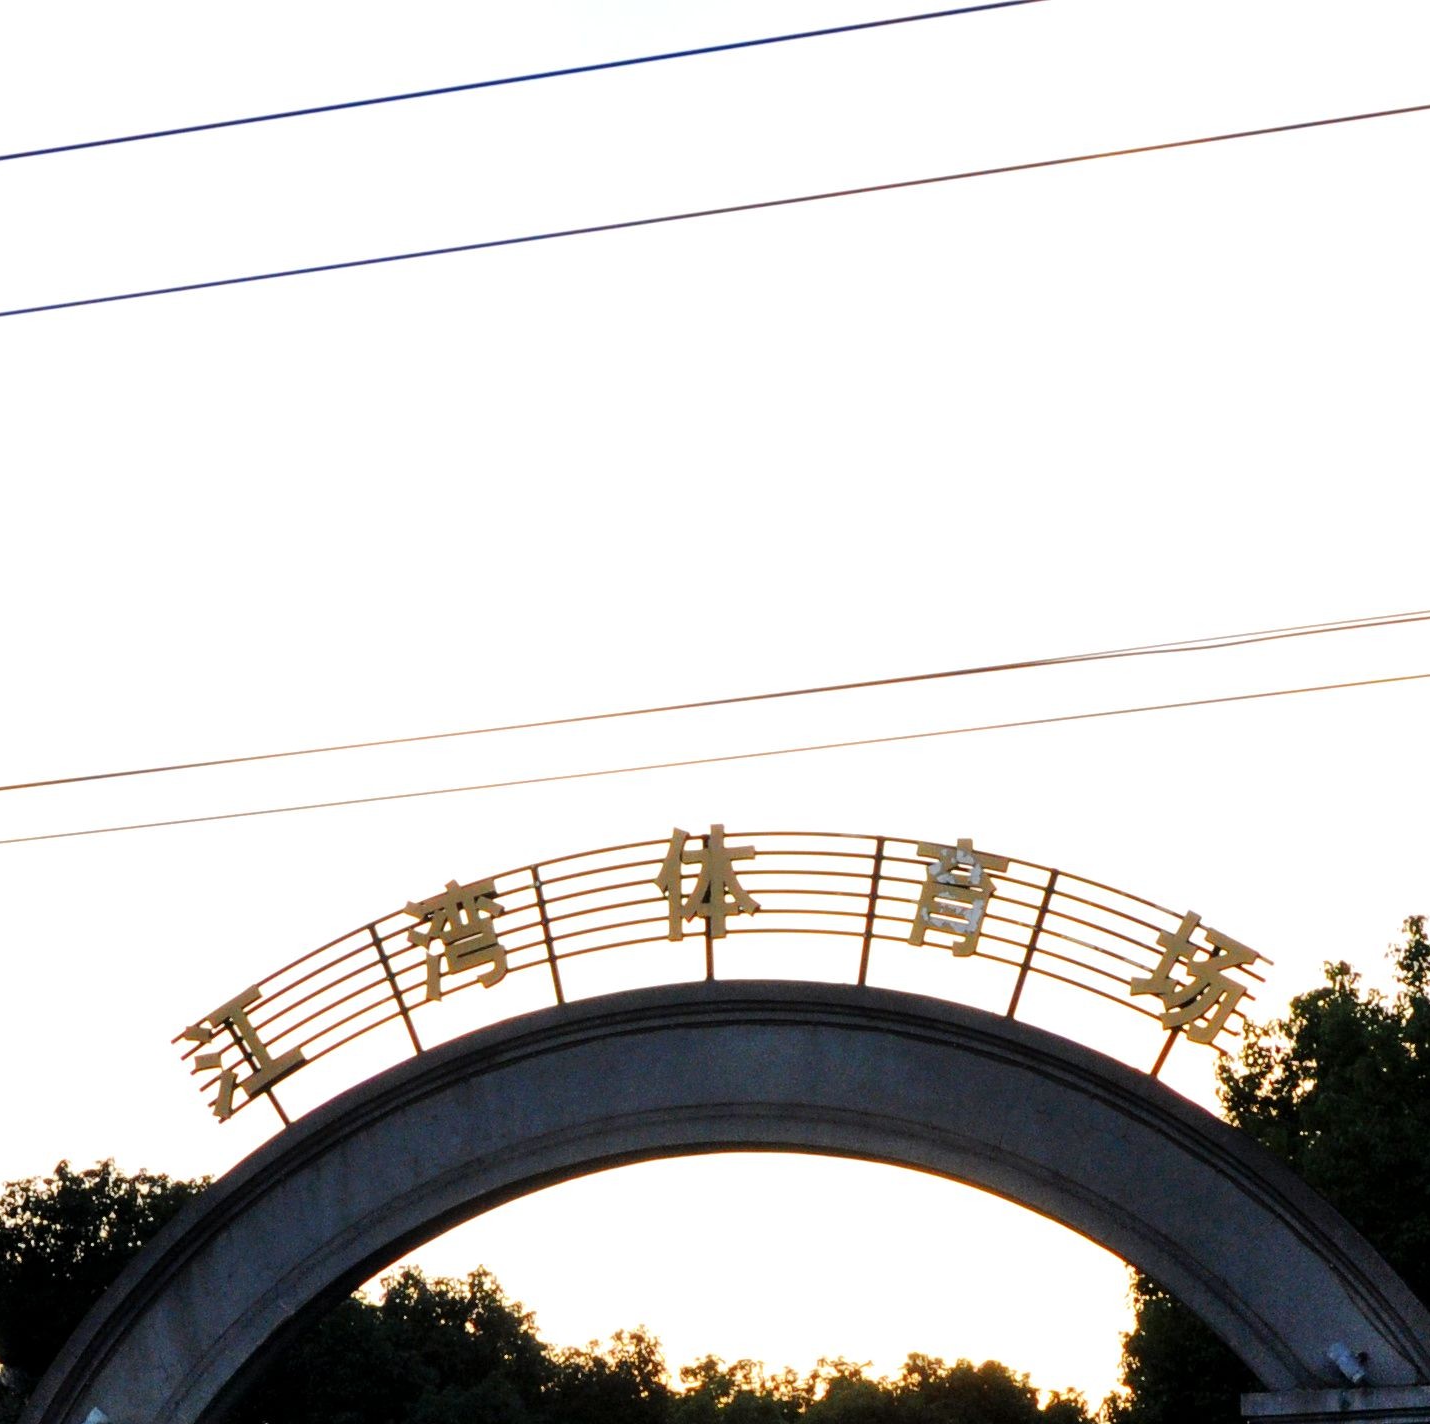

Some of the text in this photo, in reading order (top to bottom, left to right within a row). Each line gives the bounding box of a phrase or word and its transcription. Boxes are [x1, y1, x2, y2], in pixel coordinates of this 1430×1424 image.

[184, 823, 1261, 1122] 江湾体育场
